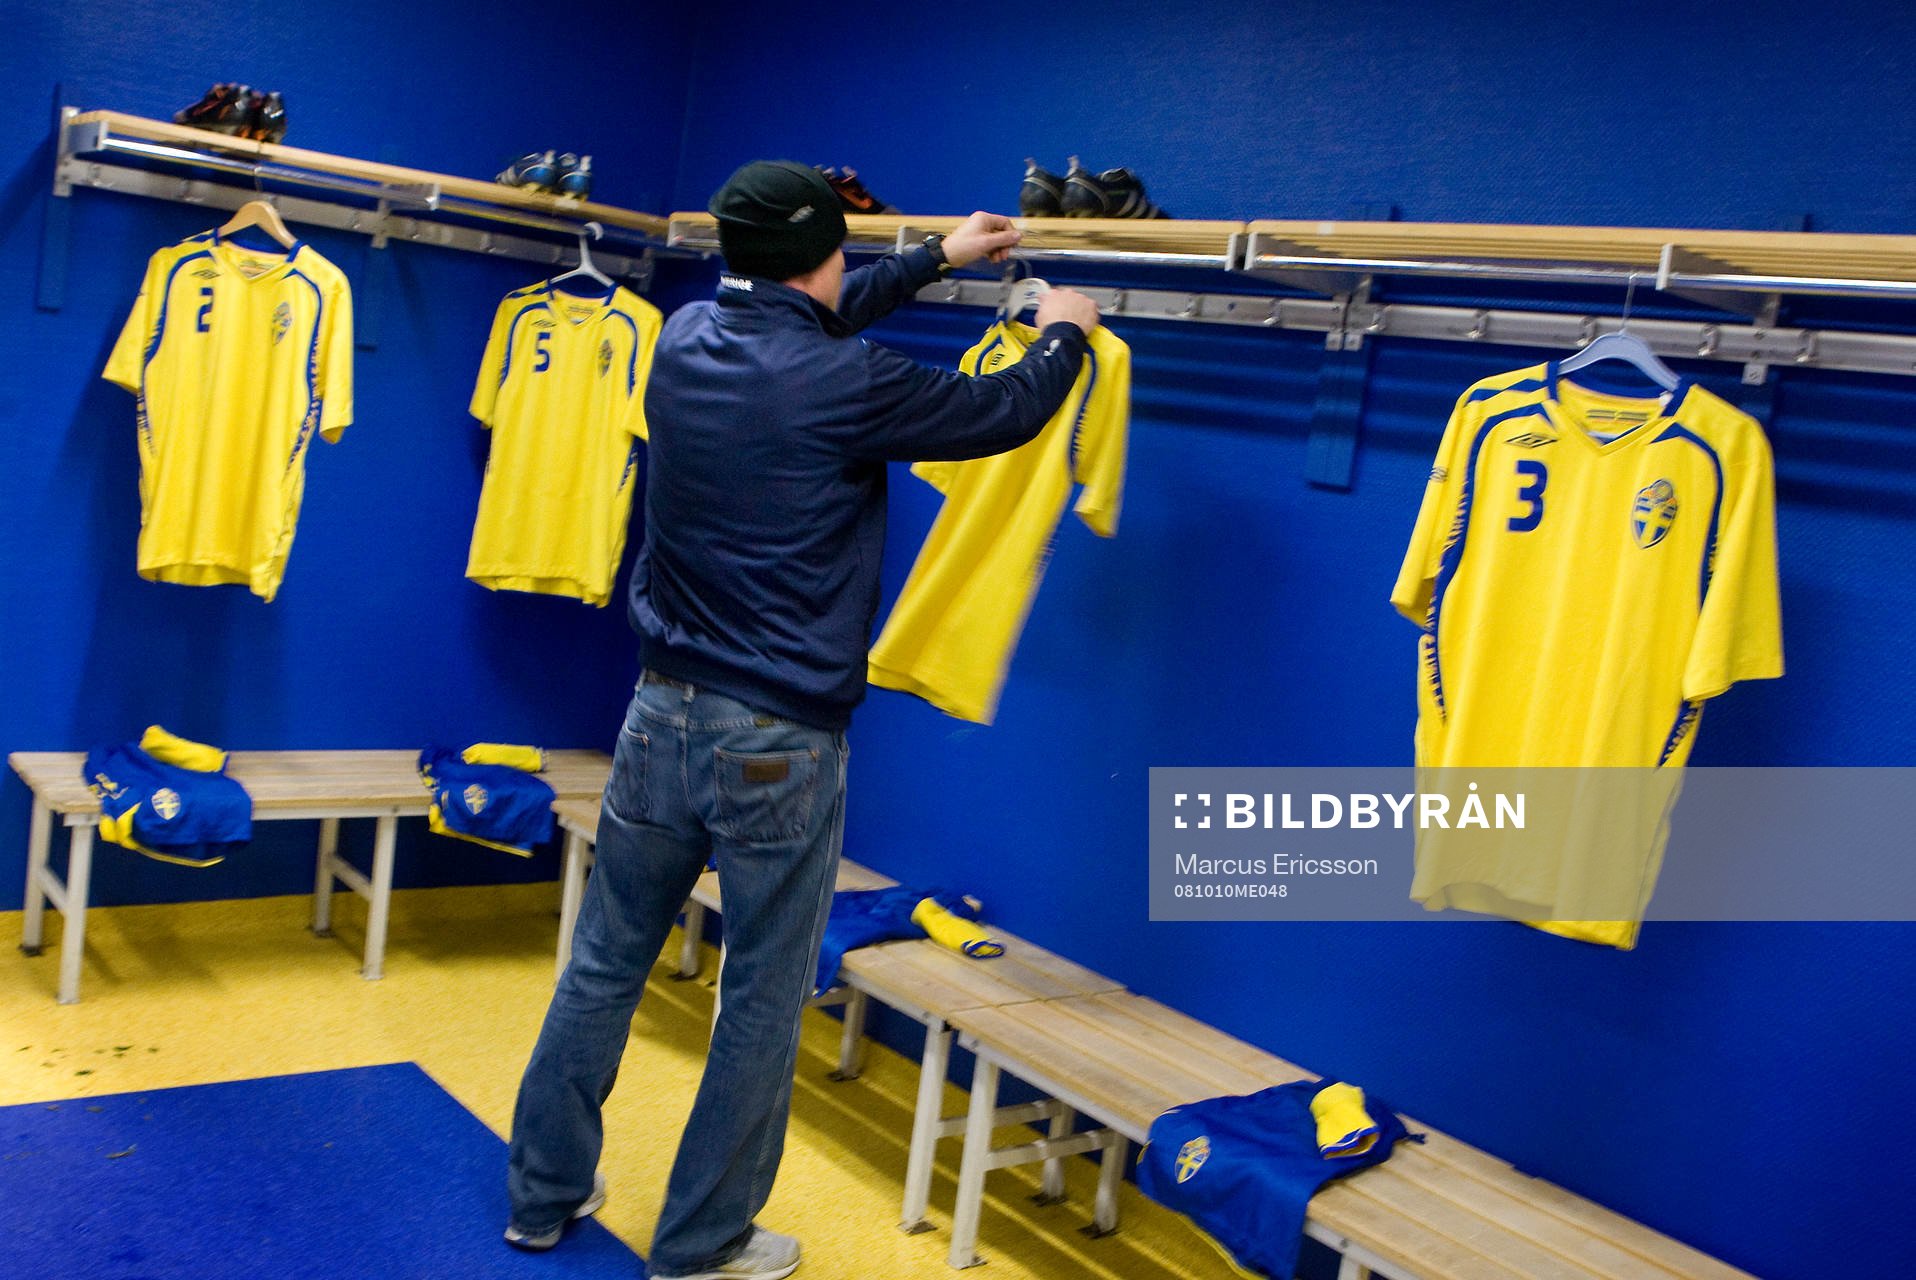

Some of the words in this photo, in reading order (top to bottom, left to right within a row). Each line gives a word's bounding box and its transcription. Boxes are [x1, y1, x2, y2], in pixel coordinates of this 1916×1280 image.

[195, 286, 214, 333] 2
[533, 331, 552, 373] 5
[1506, 459, 1549, 533] 3
